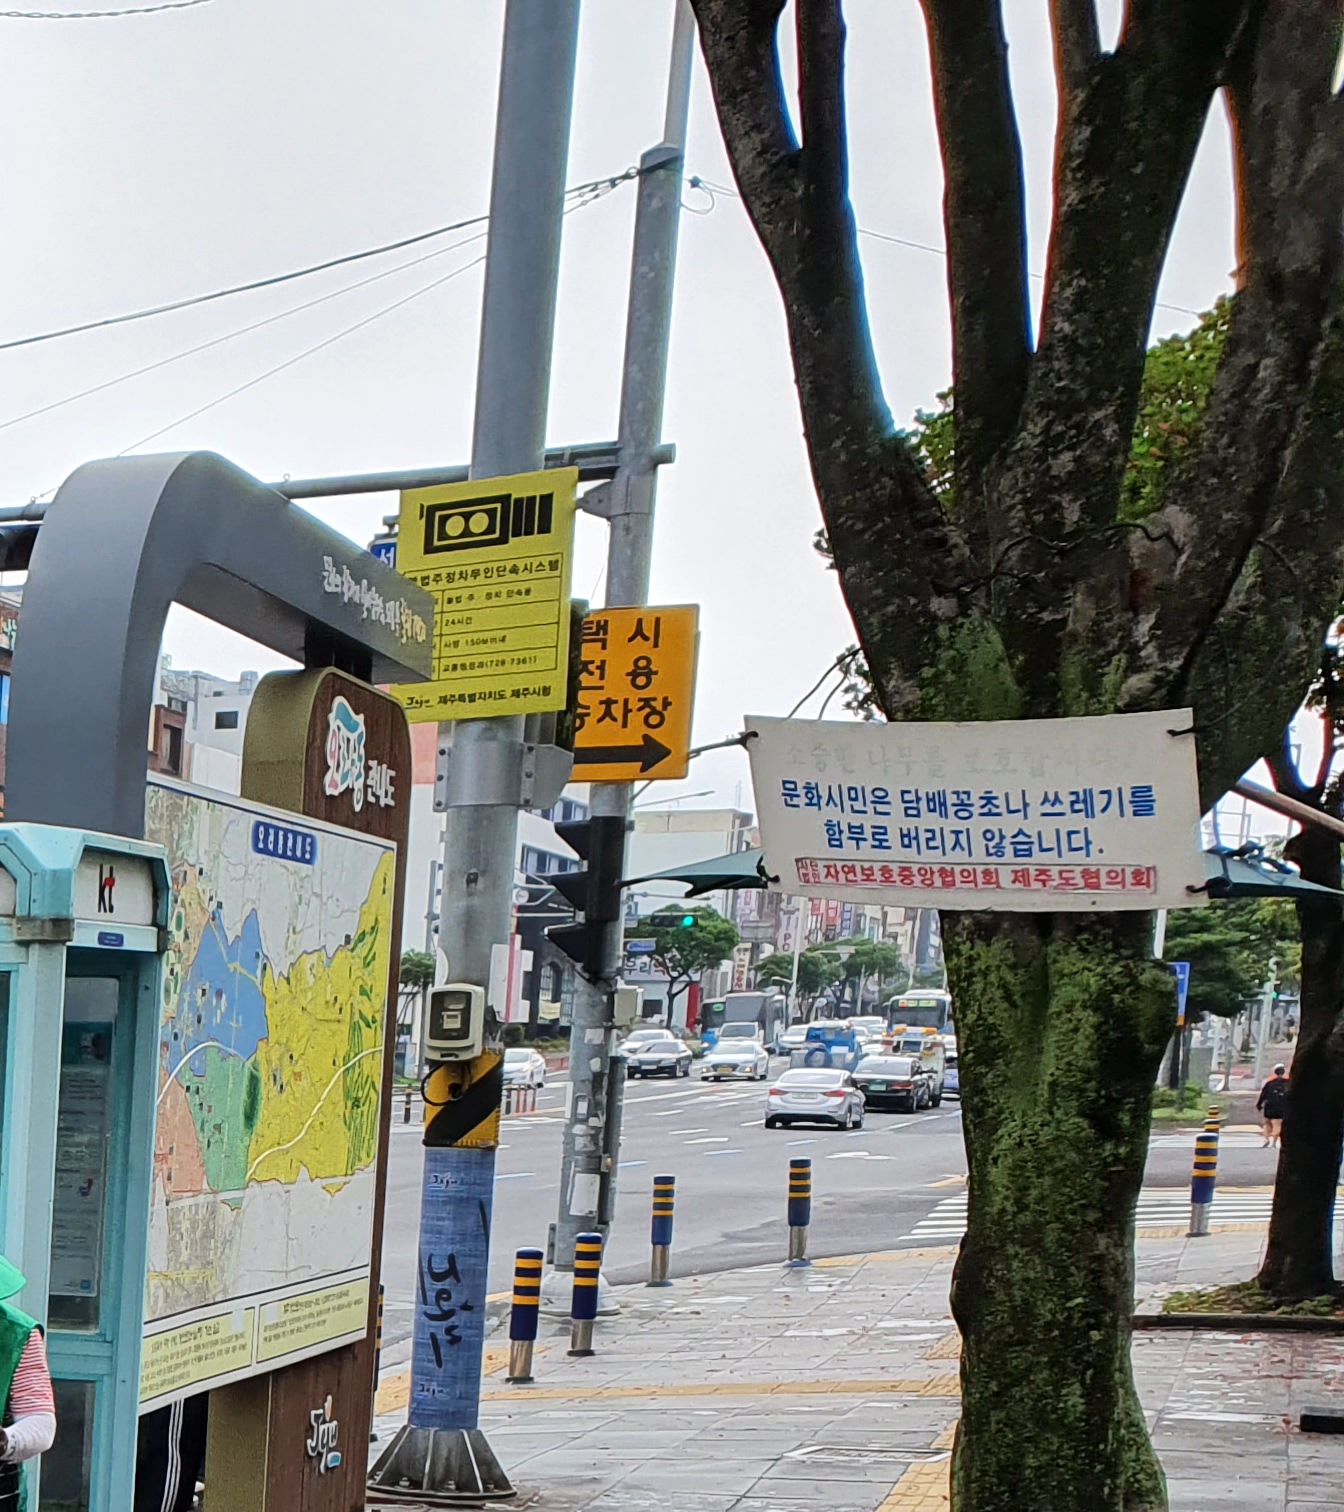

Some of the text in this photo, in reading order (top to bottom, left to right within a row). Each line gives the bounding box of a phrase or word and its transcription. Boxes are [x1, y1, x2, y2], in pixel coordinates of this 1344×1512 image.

[780, 778, 1158, 822] 문화시민은 담배꽁초나 쓰레기를
[823, 818, 1106, 859] 함부로 버리지 않습니다.
[823, 863, 1001, 890] 자연보호중앙협의회
[1010, 865, 1154, 891] 제주도협의회
